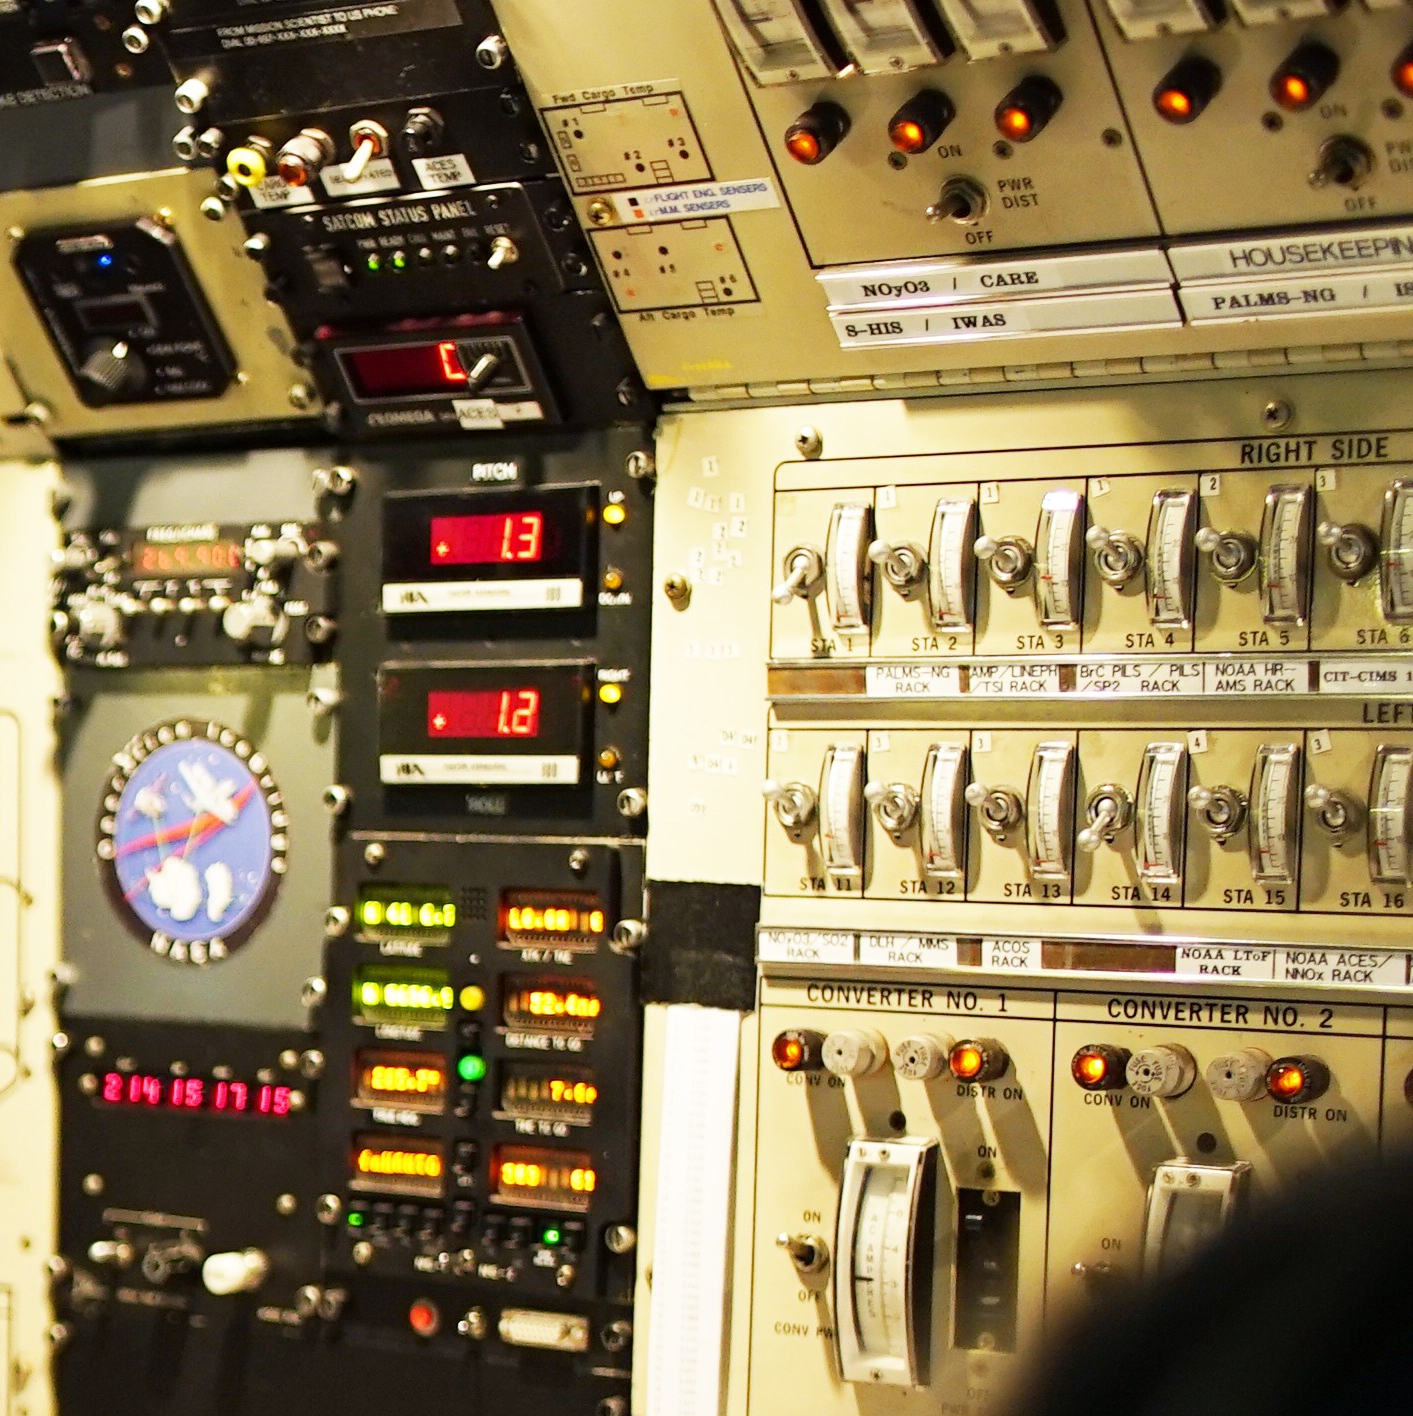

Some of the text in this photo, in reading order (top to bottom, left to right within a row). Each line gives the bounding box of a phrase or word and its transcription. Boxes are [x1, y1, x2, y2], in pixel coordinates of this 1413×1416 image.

[553, 83, 654, 104] Fwd Cargo Temp
[937, 143, 963, 160] ON
[997, 177, 1034, 193] PWR
[684, 200, 731, 213] SENSERS
[1002, 192, 1040, 210] DIST
[322, 200, 477, 233] SATCOM STATUS PANEL
[964, 230, 994, 246] OFF
[862, 271, 1040, 299] NOyO3 CARE
[1211, 287, 1337, 310] PALMS-NG
[662, 310, 697, 322] Cargo
[703, 306, 735, 319] Temp
[846, 313, 1007, 338] S-HIS IWAS
[1240, 436, 1389, 464] RIGHT SIDE
[472, 462, 518, 481] PITCH
[501, 516, 542, 559] 1.3
[911, 636, 957, 651] STA 2
[1016, 635, 1064, 650] STA 3
[1124, 633, 1175, 648] STA 4
[1239, 632, 1290, 647] STA 5
[1357, 628, 1410, 644] STA 6
[811, 638, 837, 652] STA
[876, 666, 950, 679] PALMS-NG
[1080, 664, 1200, 679] BrC PILS PILS
[1215, 663, 1256, 677] NOAA
[1323, 671, 1397, 682] CIT-CIMS
[895, 681, 931, 693] RACK
[1010, 679, 1048, 692] RACK
[1141, 679, 1181, 692] RACK
[1216, 679, 1296, 692] AMS RACK
[497, 691, 537, 733] 1.2
[800, 879, 852, 891] STA 11
[900, 880, 955, 895] STA 12
[1004, 883, 1061, 898] STA 13
[1111, 886, 1171, 900] STA 14
[1224, 889, 1285, 905] STA 15
[1340, 892, 1404, 908] STA 16
[919, 938, 949, 951] MMS
[992, 941, 1030, 954] ACOS
[787, 948, 821, 960] RACK
[888, 951, 923, 963] RACK
[992, 955, 1028, 968] RACK
[1181, 948, 1224, 961] NOAA
[1286, 952, 1392, 969] NOAA ACES/
[1200, 964, 1241, 976] RACK
[1285, 969, 1373, 982] NNOx RACK
[807, 982, 1007, 1012] CONVERTER NO. 1
[1107, 998, 1333, 1029] CONVERTER NO. 2
[786, 1073, 846, 1088] CONV ON
[172, 1078, 203, 1107] 15
[215, 1081, 248, 1111] 17
[260, 1085, 292, 1115] 15
[956, 1084, 1023, 1100] DISTR ON
[1084, 1092, 1151, 1109] CONV ON
[1273, 1104, 1347, 1122] DISTR ON
[977, 1146, 997, 1158] ON
[803, 1211, 821, 1222] ON
[798, 1290, 820, 1302] OFF
[774, 1322, 834, 1339] CONV PW
